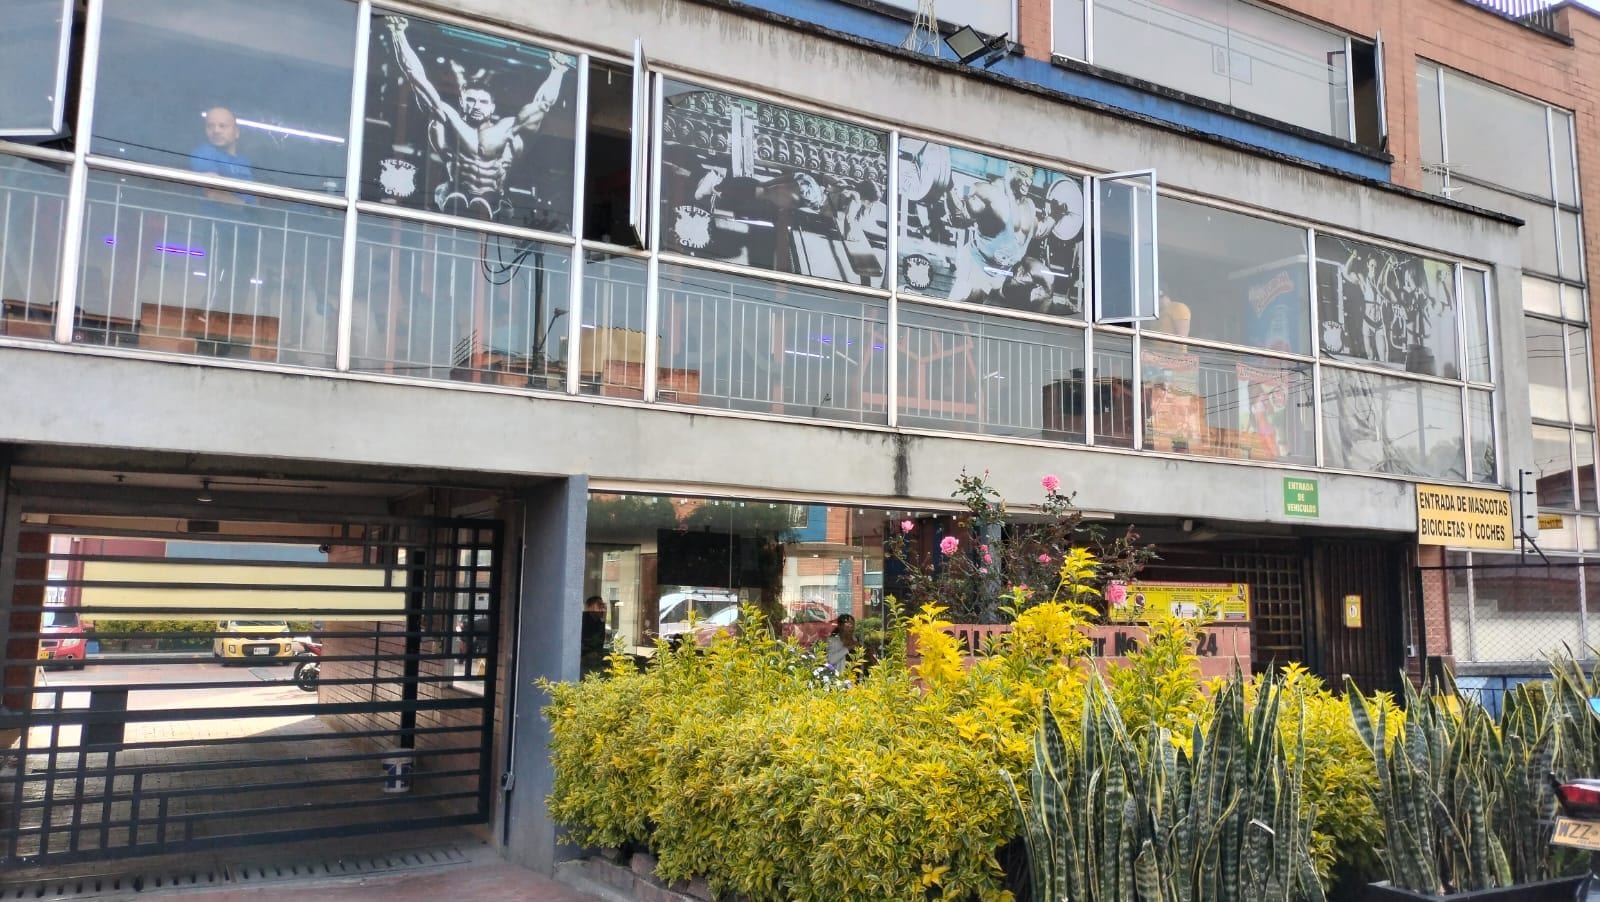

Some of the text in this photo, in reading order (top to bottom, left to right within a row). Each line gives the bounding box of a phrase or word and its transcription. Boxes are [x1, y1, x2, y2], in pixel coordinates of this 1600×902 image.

[1288, 481, 1314, 491] ENTRADA
[1297, 493, 1305, 501] DE
[1287, 503, 1317, 512] VEHICULOS
[1419, 492, 1508, 516] ENTRADA DE MASCOTAS
[1421, 518, 1505, 541] BICICLETAS Y COCHES
